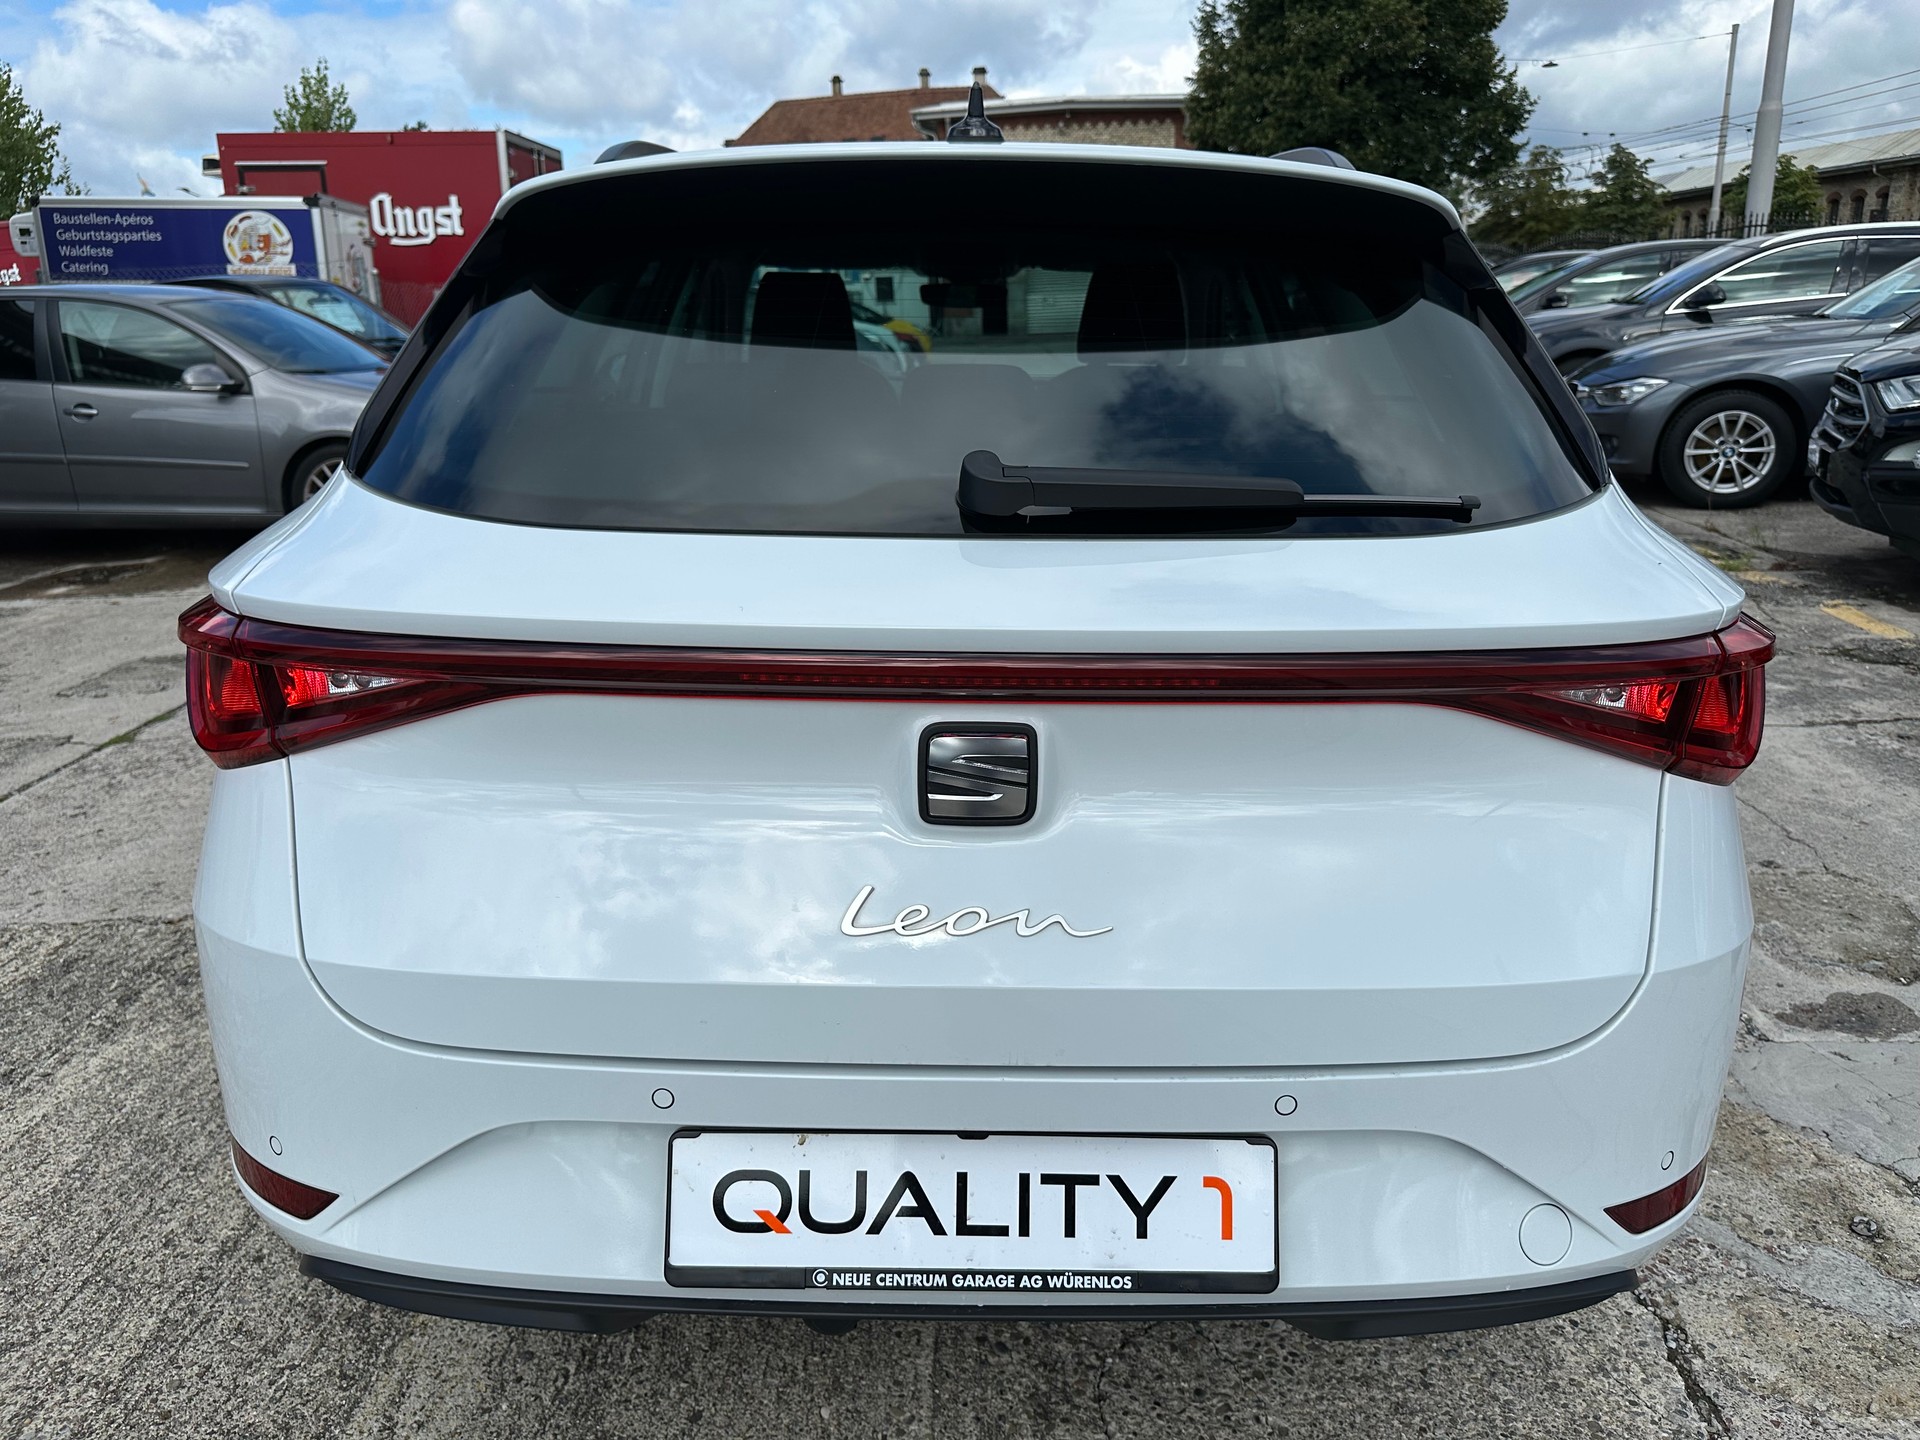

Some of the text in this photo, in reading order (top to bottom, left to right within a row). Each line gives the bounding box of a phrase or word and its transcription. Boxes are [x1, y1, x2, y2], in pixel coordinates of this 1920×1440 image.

[53, 212, 154, 227] Baustellen-Apéros
[370, 192, 464, 246] Angst
[56, 229, 162, 243] Geburtstagsparties
[58, 245, 114, 257] Waldfeste
[0, 263, 22, 286] gst
[61, 261, 109, 275] Catering
[840, 884, 1114, 938] Leon
[712, 1169, 1232, 1241] QUALITY 1
[832, 1272, 1132, 1289] NEUE CENTRUM GARAGE AG WÜRENLOS
